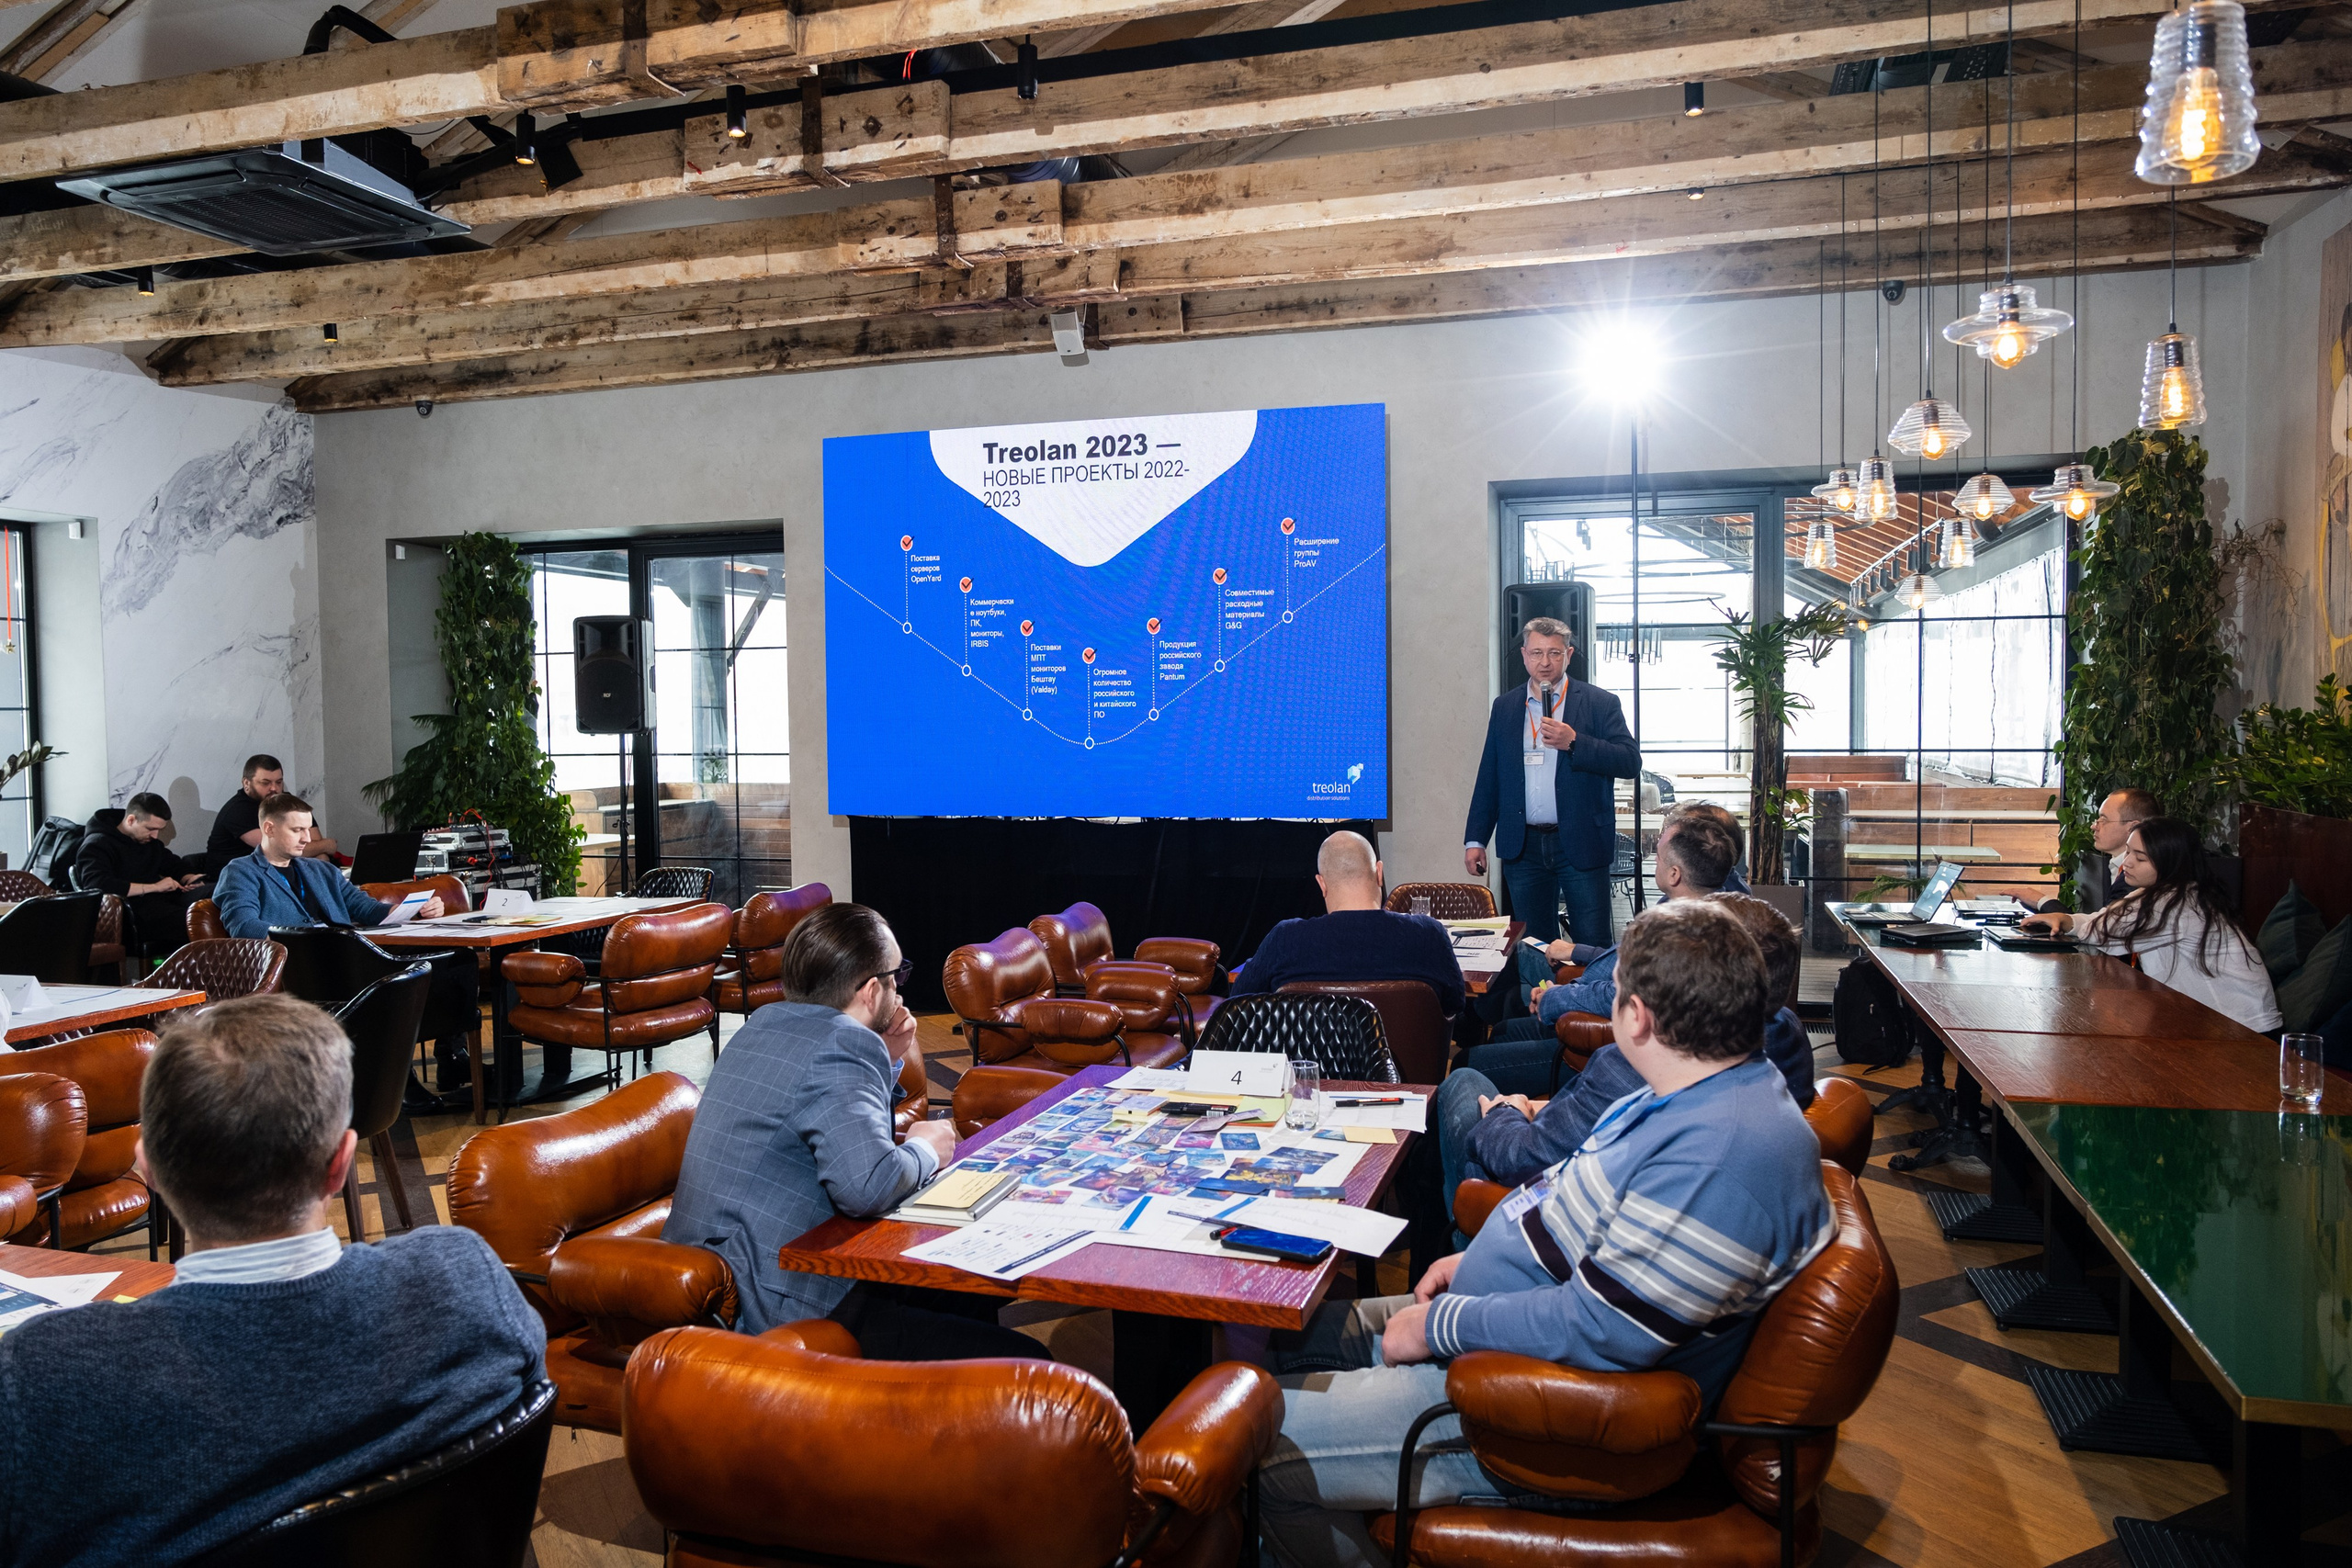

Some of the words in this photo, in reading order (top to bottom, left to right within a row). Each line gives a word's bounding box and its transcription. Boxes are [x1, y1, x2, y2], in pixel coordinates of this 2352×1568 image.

[982, 439, 1077, 464] Treolan
[1086, 433, 1148, 458] 2023
[983, 468, 1046, 487] НОВЫЕ
[1051, 462, 1138, 483] ПРОЕКТЫ
[1144, 460, 1190, 479] 2022-
[983, 490, 1021, 509] 2023
[1294, 538, 1340, 547] Расширение
[910, 575, 942, 583] OpenYard
[1225, 589, 1274, 597] Совместимые
[1225, 601, 1263, 610] расходные
[976, 608, 1007, 617] ноутбуки,
[970, 619, 982, 627] ПК,
[1159, 640, 1196, 649] Продукция
[1159, 651, 1202, 660] российского
[1093, 669, 1126, 677] Огромное
[1159, 672, 1185, 681] Pantum
[1031, 675, 1056, 684] Бештау
[1031, 685, 1057, 694] (Valday)
[1093, 690, 1135, 698] российского
[1094, 710, 1105, 718] ПО
[1312, 781, 1351, 793] treolan
[502, 897, 508, 907] 2
[1230, 1070, 1242, 1086] 4
